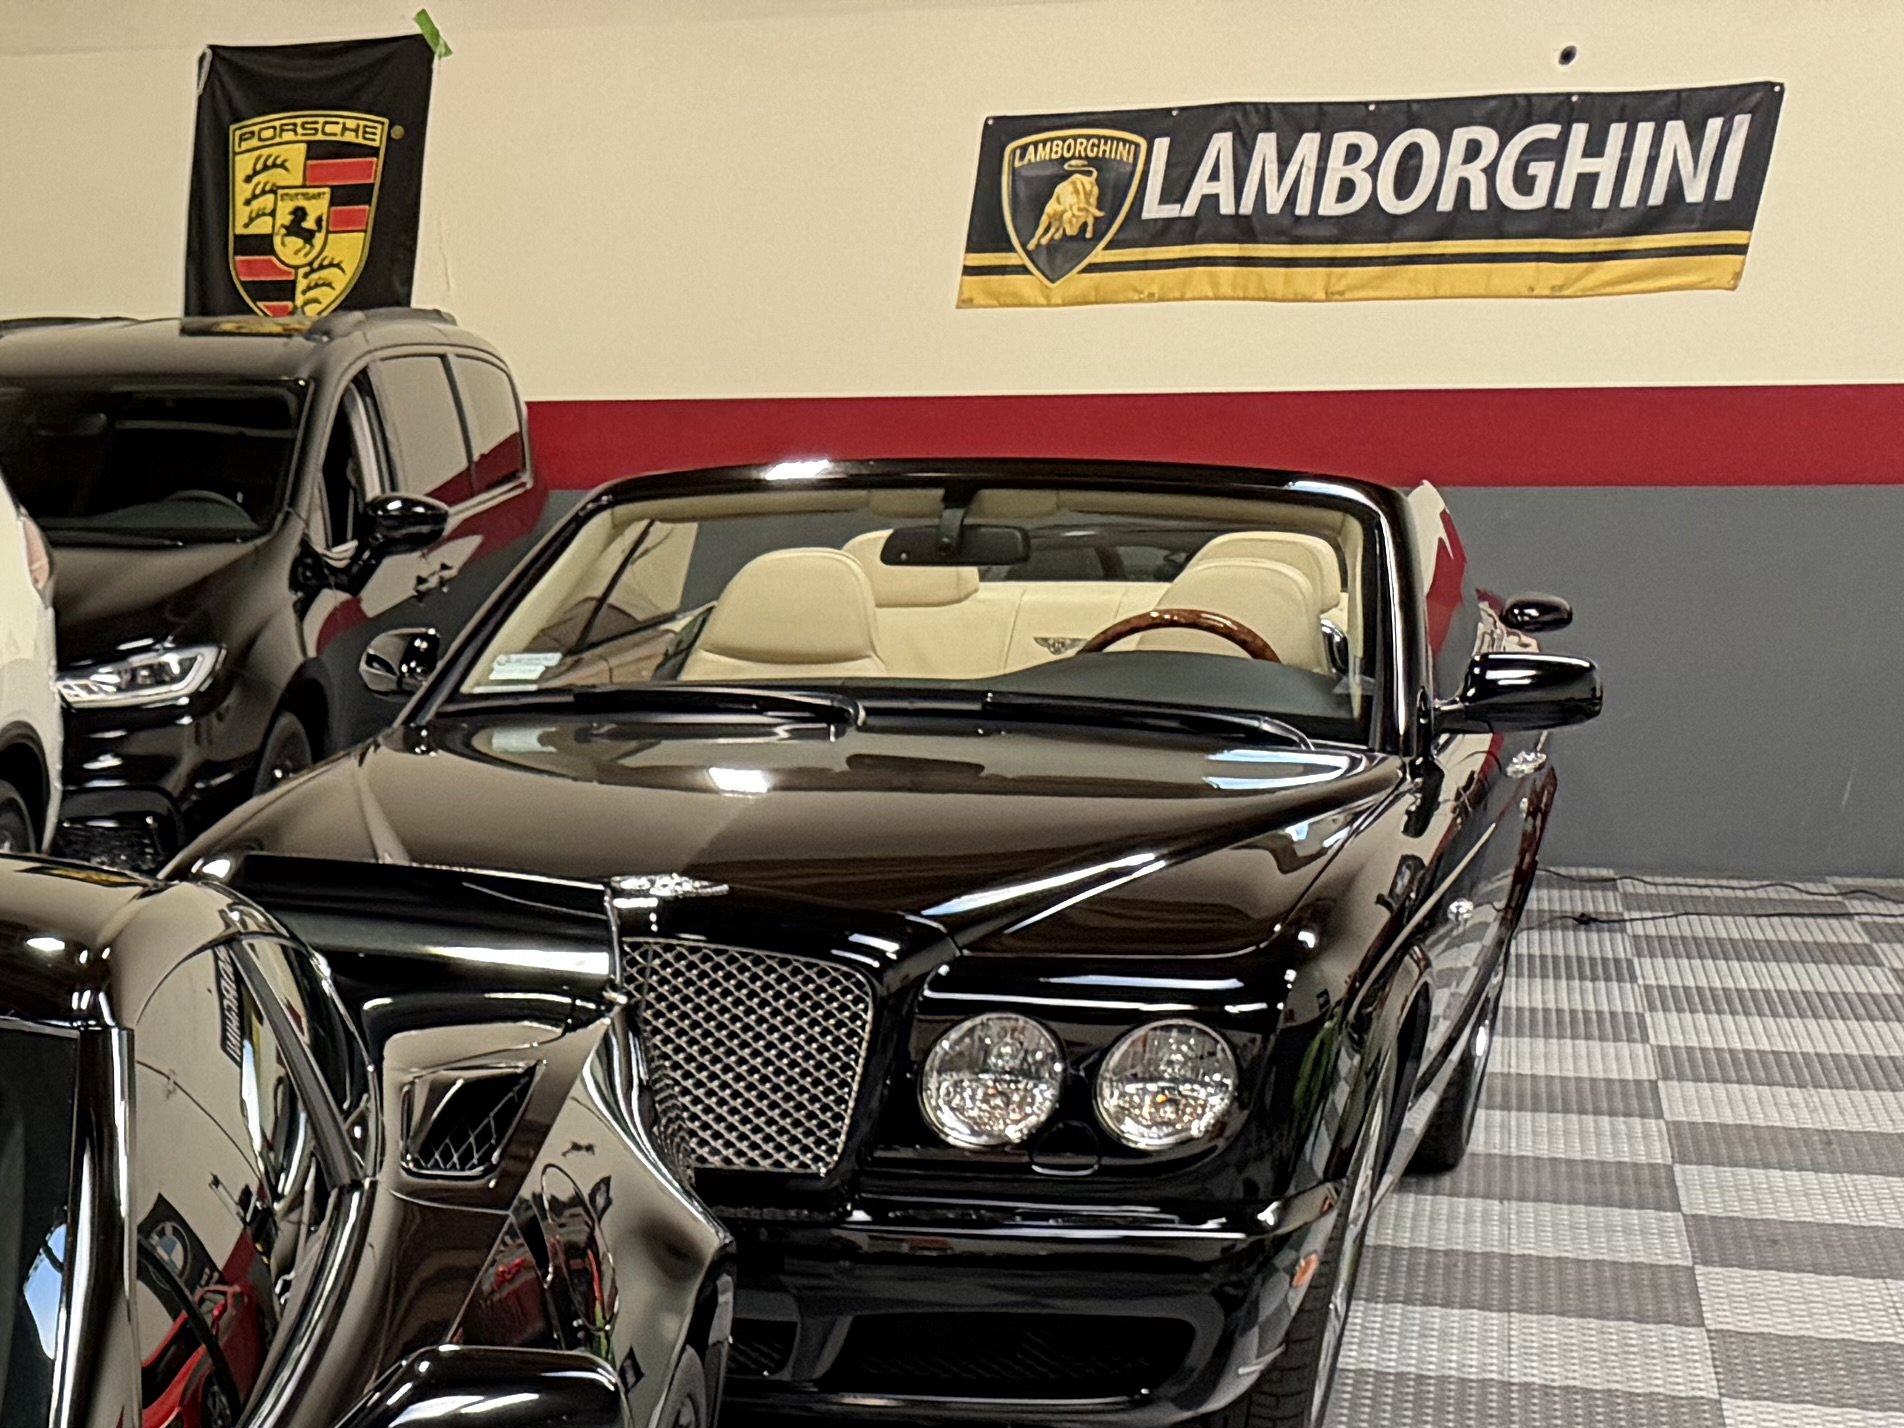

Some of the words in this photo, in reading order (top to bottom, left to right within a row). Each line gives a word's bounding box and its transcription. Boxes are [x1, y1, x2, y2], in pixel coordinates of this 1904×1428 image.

[238, 120, 379, 149] PORSCHE
[1014, 138, 1136, 168] LAMBORGHINI
[1141, 113, 1752, 220] LAMBORGHINI
